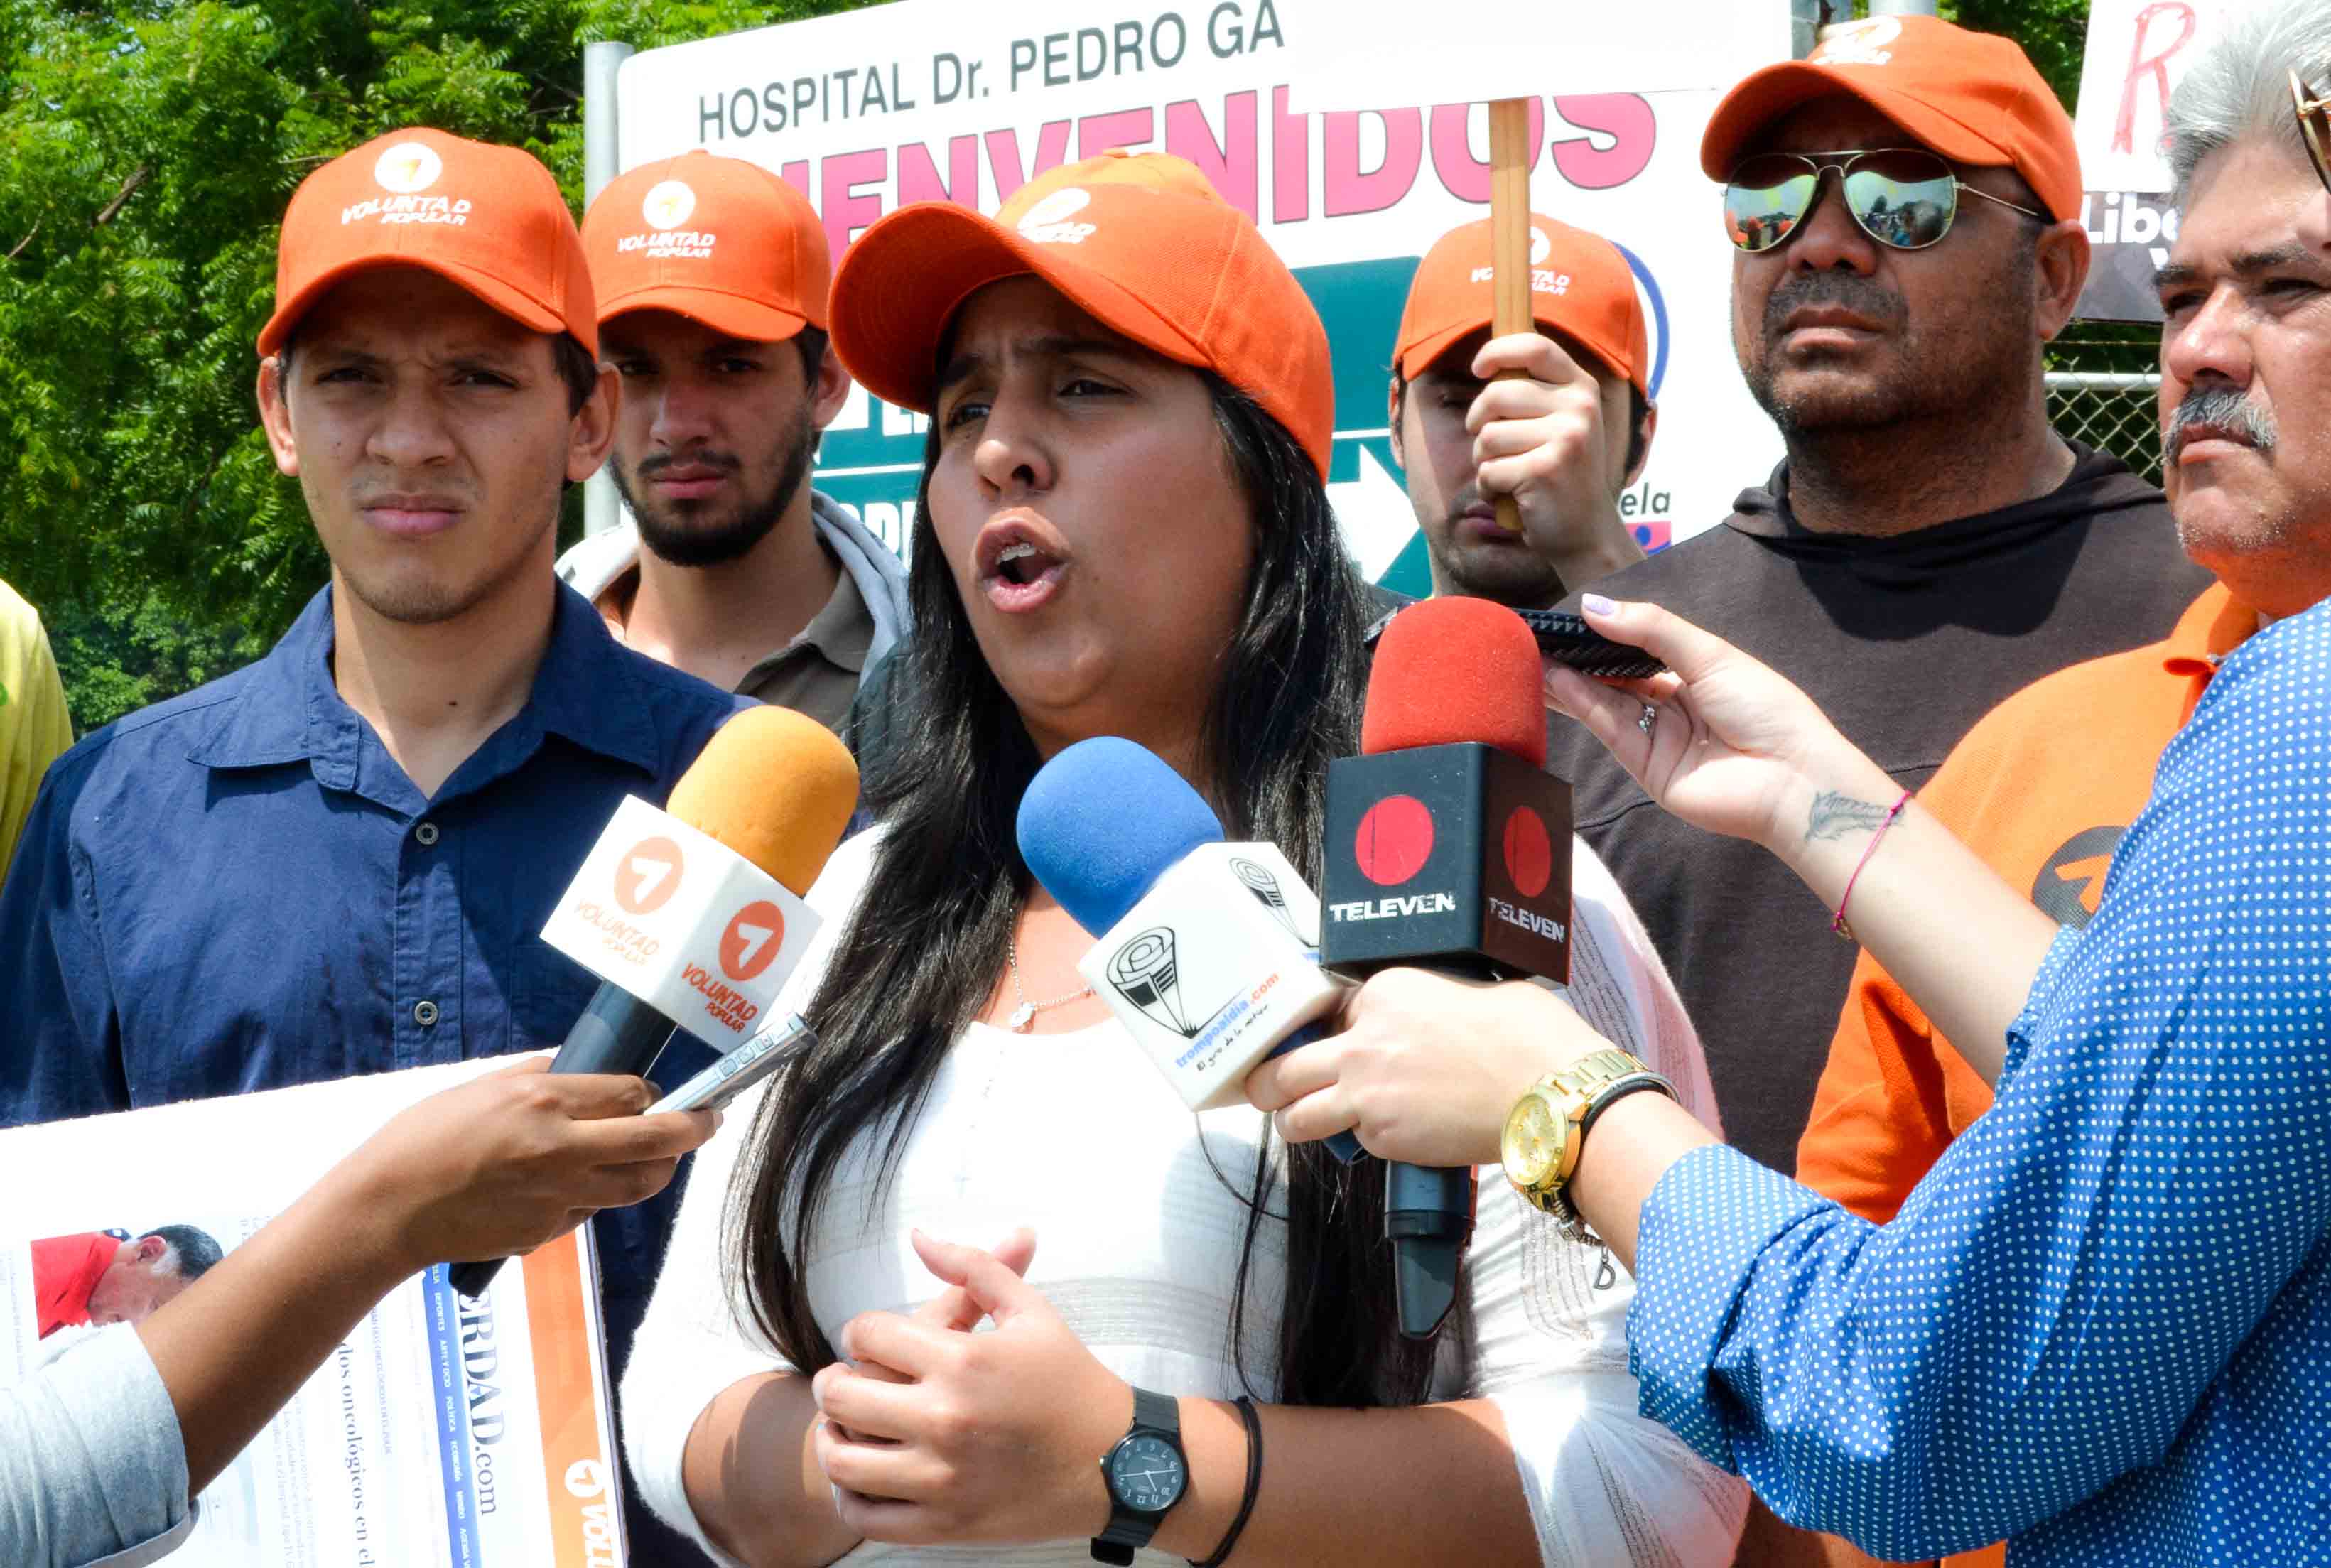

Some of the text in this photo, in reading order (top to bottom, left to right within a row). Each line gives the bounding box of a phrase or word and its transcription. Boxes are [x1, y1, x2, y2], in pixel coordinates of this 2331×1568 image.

[699, 63, 915, 143] HOSPITAL
[934, 52, 989, 104] Dr.
[1010, 12, 1186, 92] PEDRO
[341, 195, 472, 225] VOLUNTAD
[617, 230, 716, 253] VOLUNTAD
[1329, 892, 1456, 921] TELEVEN
[1489, 897, 1566, 943] TELEVEN
[573, 898, 660, 956] VOLUNTAD
[681, 962, 759, 1022] VOLUNTAD
[704, 1001, 746, 1034] POPULAR
[340, 1385, 367, 1510] oncológicos
[355, 1515, 369, 1541] en
[357, 1547, 376, 1566] el
